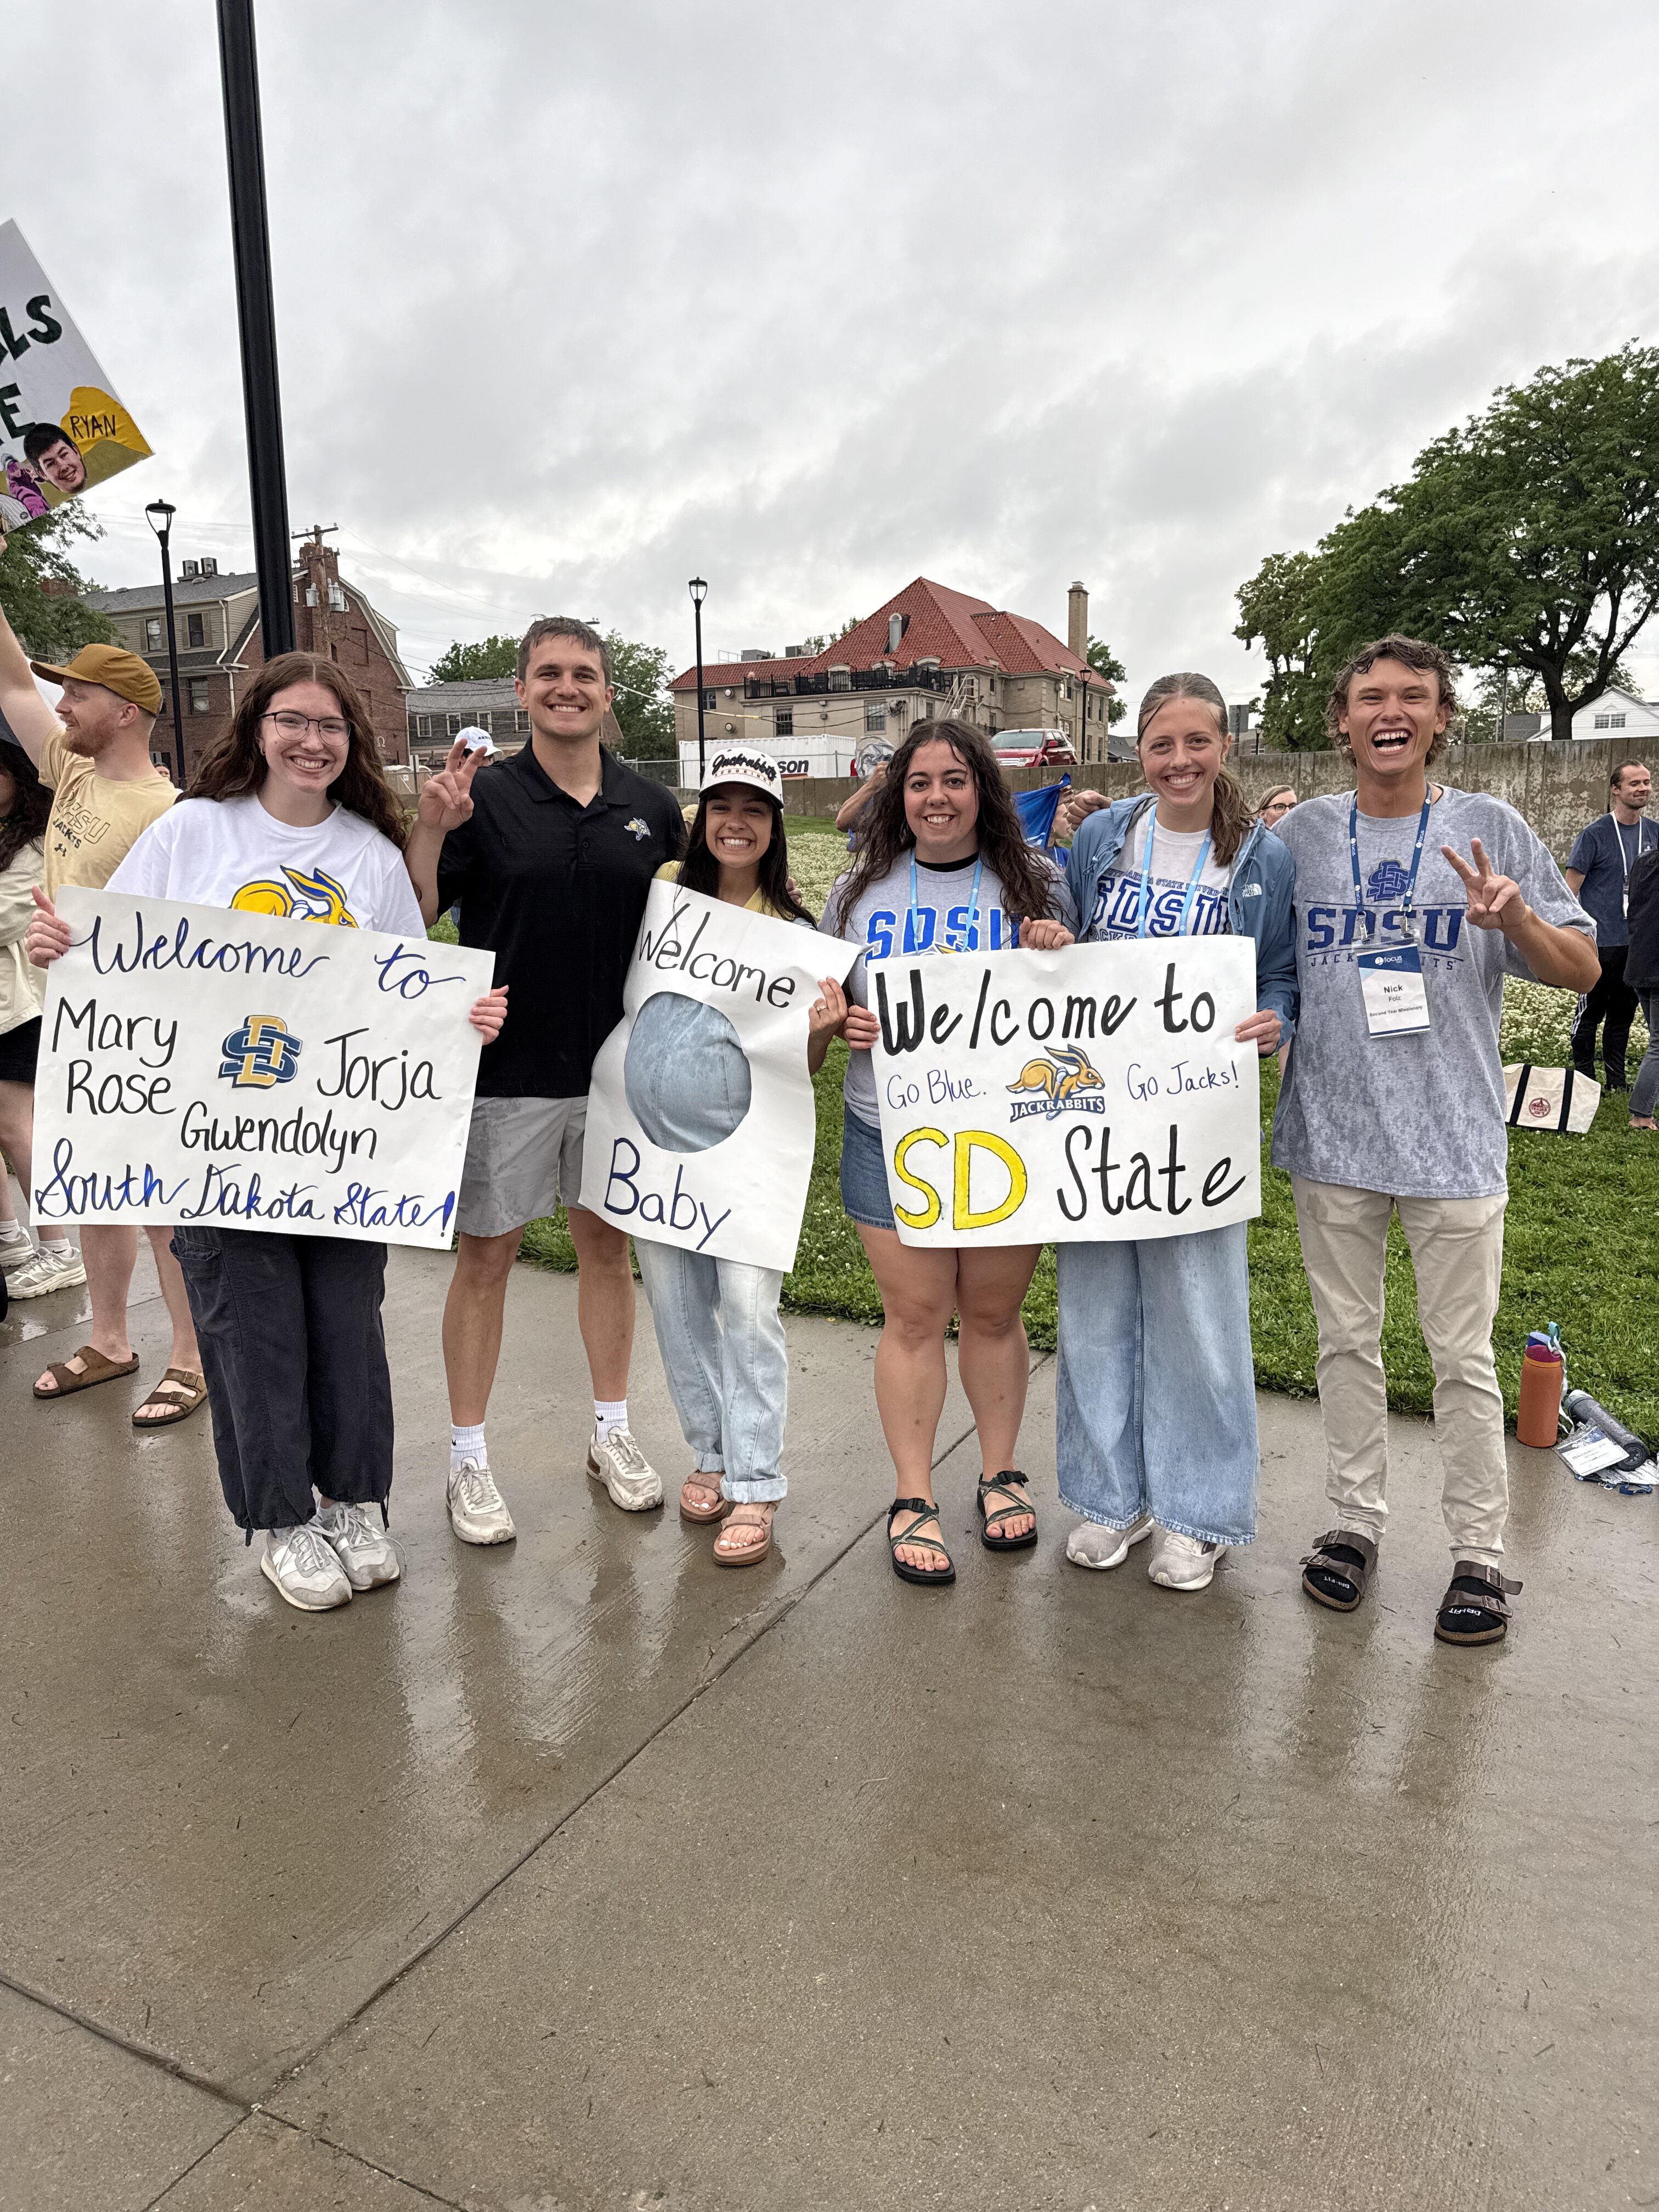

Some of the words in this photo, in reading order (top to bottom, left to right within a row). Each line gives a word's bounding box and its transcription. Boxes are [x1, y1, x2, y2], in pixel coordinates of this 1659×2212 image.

[0, 295, 62, 365] LS
[0, 382, 36, 446] E
[70, 414, 116, 439] RYAN
[712, 753, 777, 781] Jackrabbits
[714, 769, 772, 786] BROOKINGS
[777, 759, 809, 774] son
[1156, 878, 1184, 890] STATE
[1308, 907, 1465, 952] SDSU
[69, 912, 331, 978] Welcome
[374, 943, 466, 1000] to
[639, 903, 795, 1008] Welcome
[876, 969, 1137, 1056] Welcome
[1154, 963, 1215, 1033] to
[1384, 985, 1403, 994] Nick
[52, 997, 178, 1068] Mary
[67, 1059, 177, 1115] Rose
[317, 1028, 443, 1110] Jorja
[887, 1075, 919, 1110] Go
[928, 1069, 987, 1104] Blue.
[1126, 1063, 1158, 1102] Go
[1167, 1060, 1239, 1095] Jacks!
[1011, 1097, 1104, 1121] JACKRABBITS
[181, 1101, 376, 1174] Gwendolyn
[35, 1138, 190, 1218] South
[180, 1164, 325, 1221] Dakota
[334, 1182, 455, 1238] State!
[603, 1137, 732, 1250] Baby
[894, 1126, 1028, 1231] SD
[1057, 1124, 1247, 1221] State
[1324, 1576, 1350, 1589] DRI-FIT
[1448, 1607, 1481, 1617] DRI-FIT
